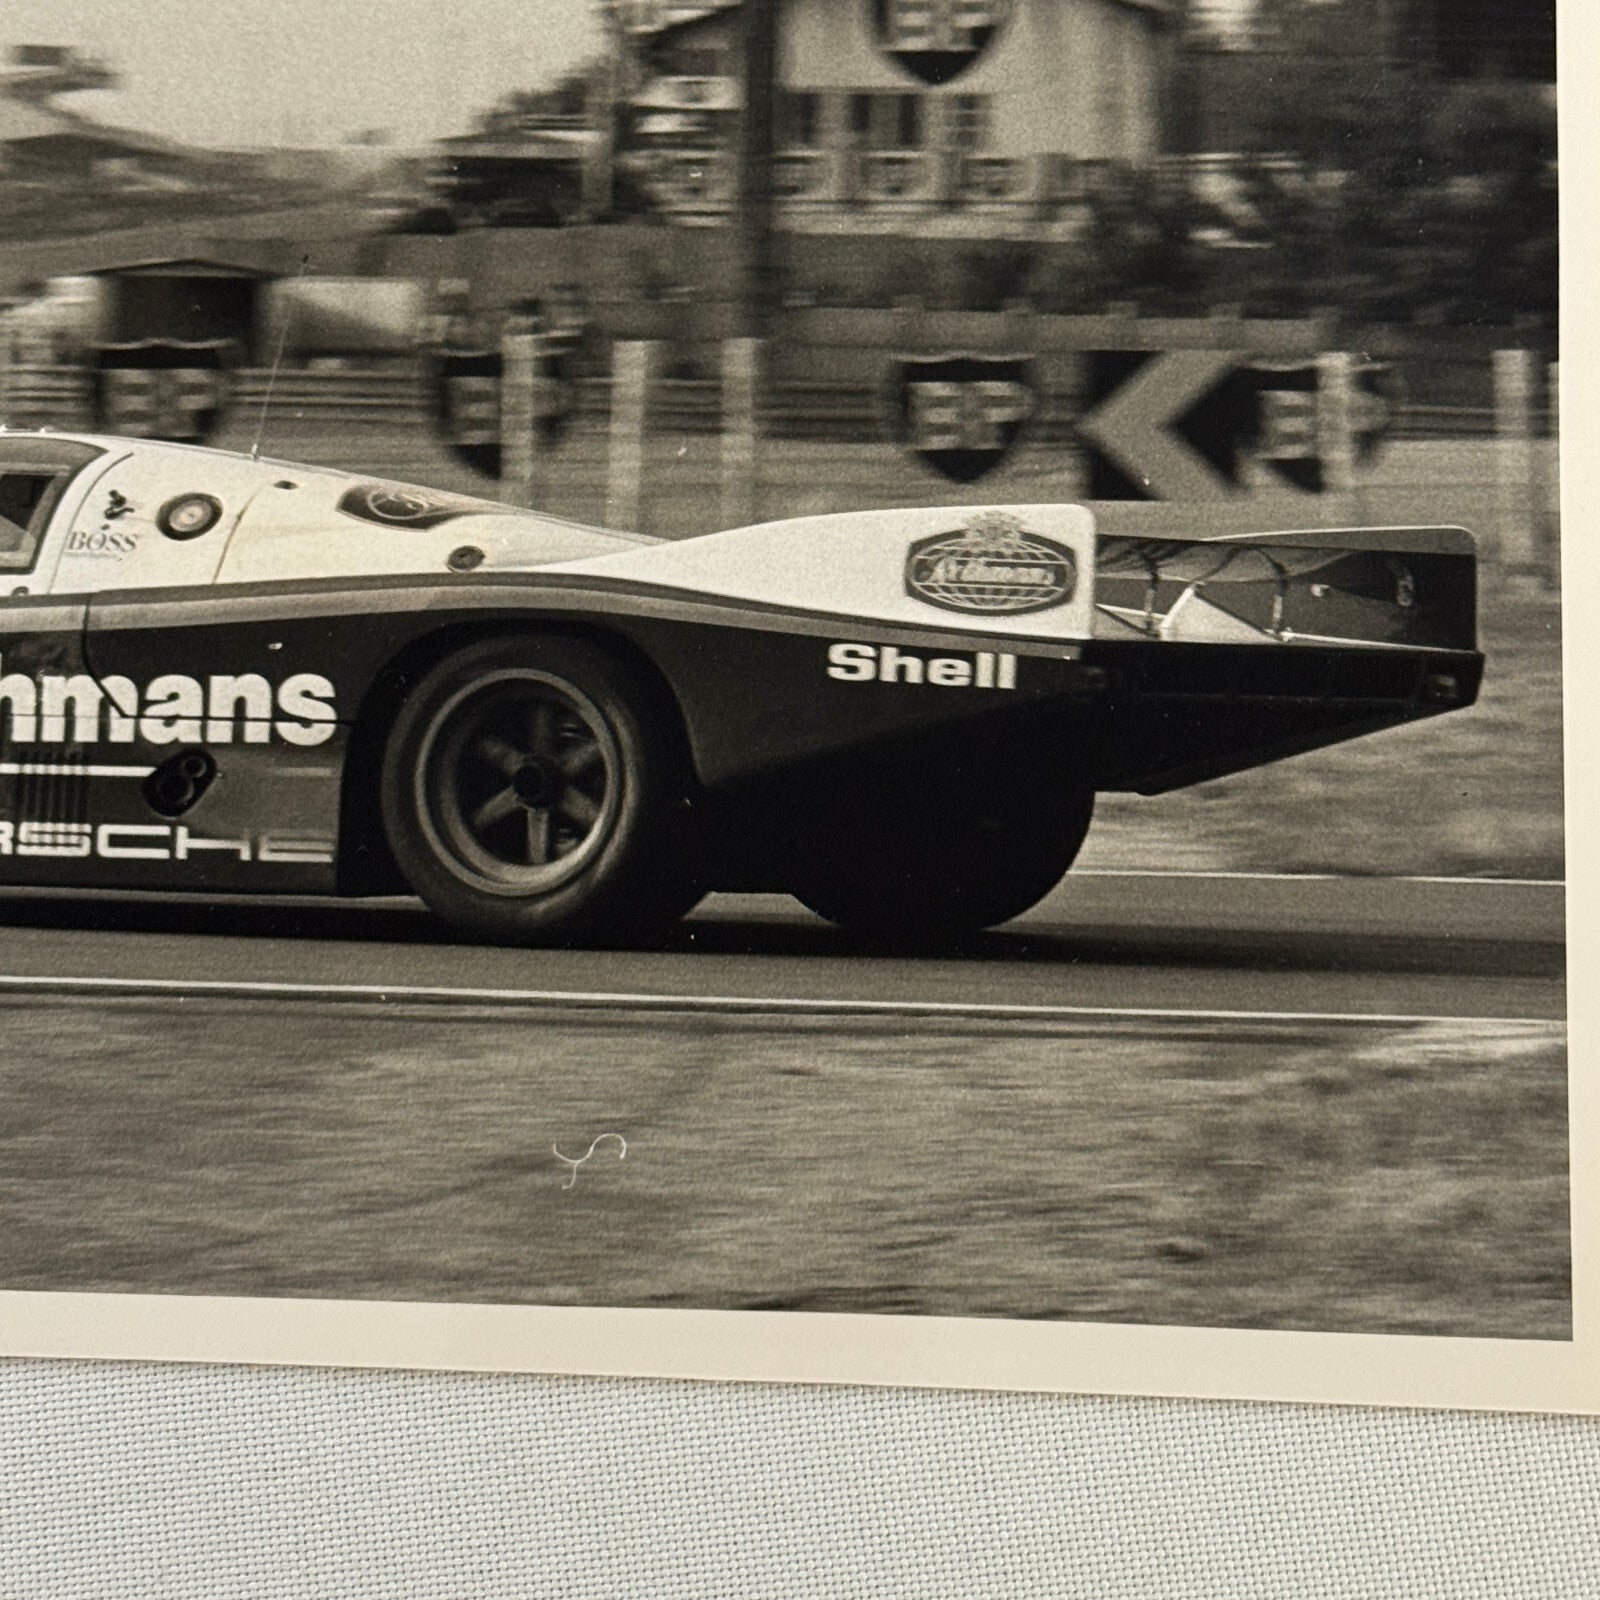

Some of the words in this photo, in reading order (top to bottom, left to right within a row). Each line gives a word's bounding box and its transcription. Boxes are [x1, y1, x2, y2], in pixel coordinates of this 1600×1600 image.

[67, 530, 138, 553] BOSS
[826, 642, 1017, 690] Shell
[0, 820, 335, 864] SCHE
